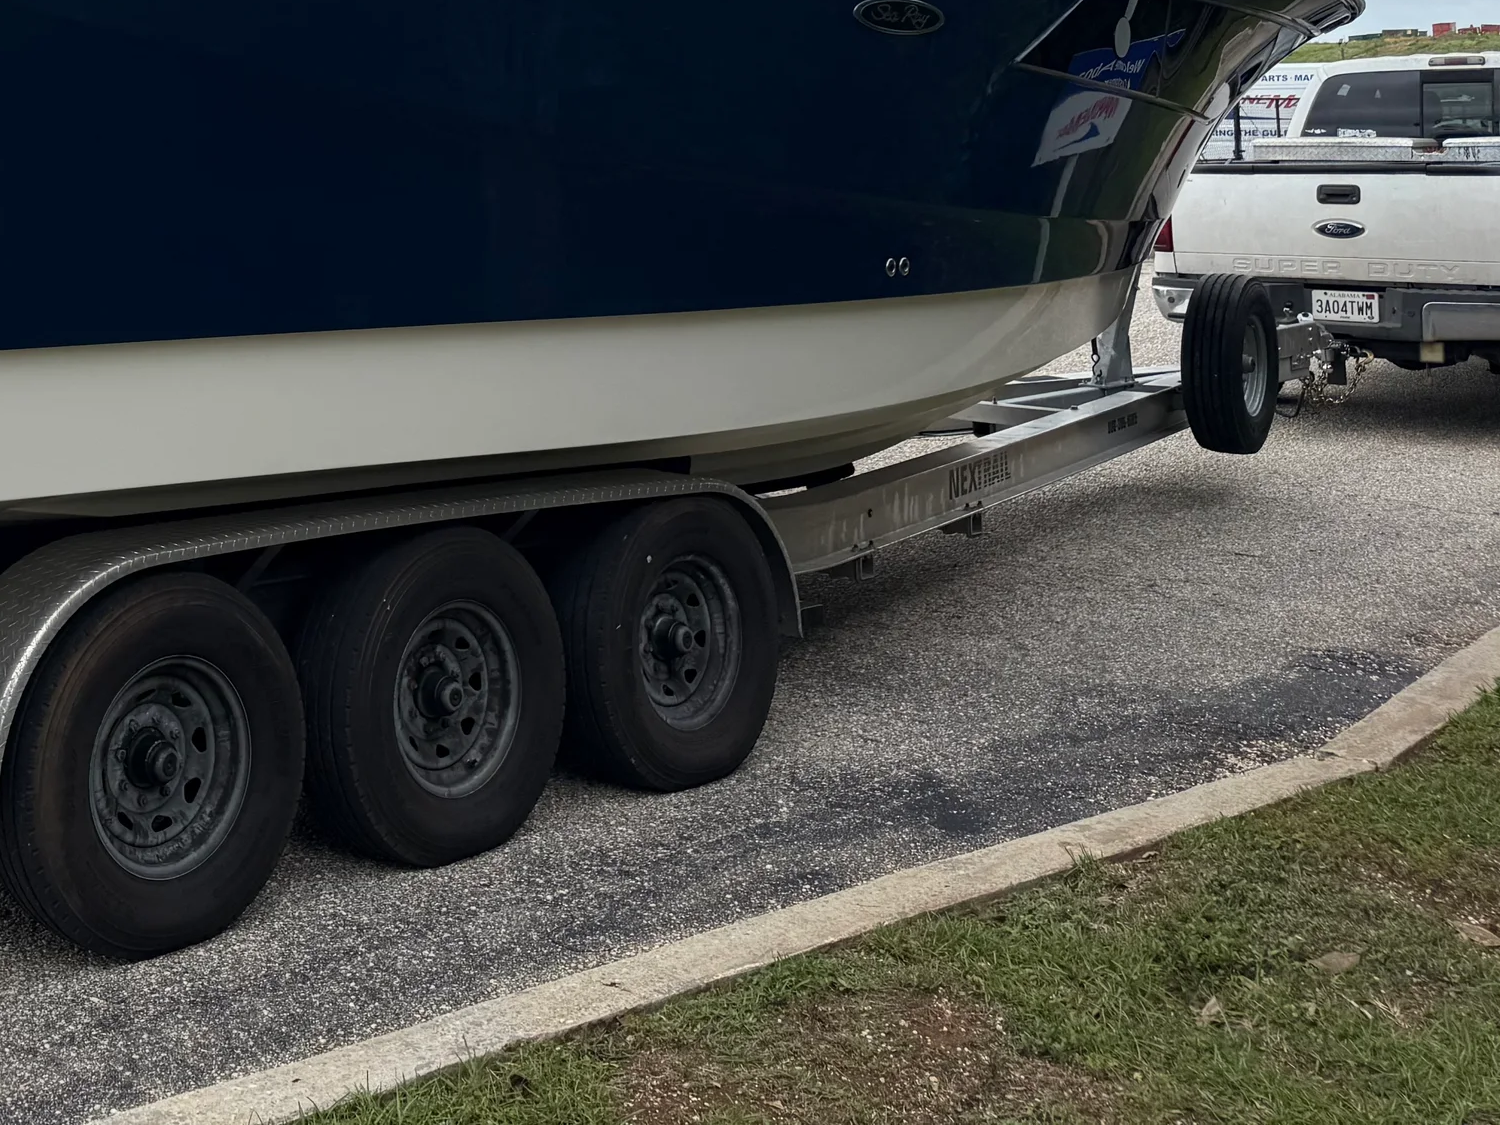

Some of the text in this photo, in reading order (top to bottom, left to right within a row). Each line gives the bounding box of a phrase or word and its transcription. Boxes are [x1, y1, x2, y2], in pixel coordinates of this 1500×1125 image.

[871, 4, 929, 29] Sea Ray
[1261, 74, 1288, 83] ARTS
[1325, 223, 1351, 234] Ford
[1232, 257, 1460, 280] SUPER DUTY
[1329, 291, 1360, 299] ALABAMA
[1316, 299, 1373, 316] 3A04TWM
[949, 451, 1011, 500] NEXTRAIL
